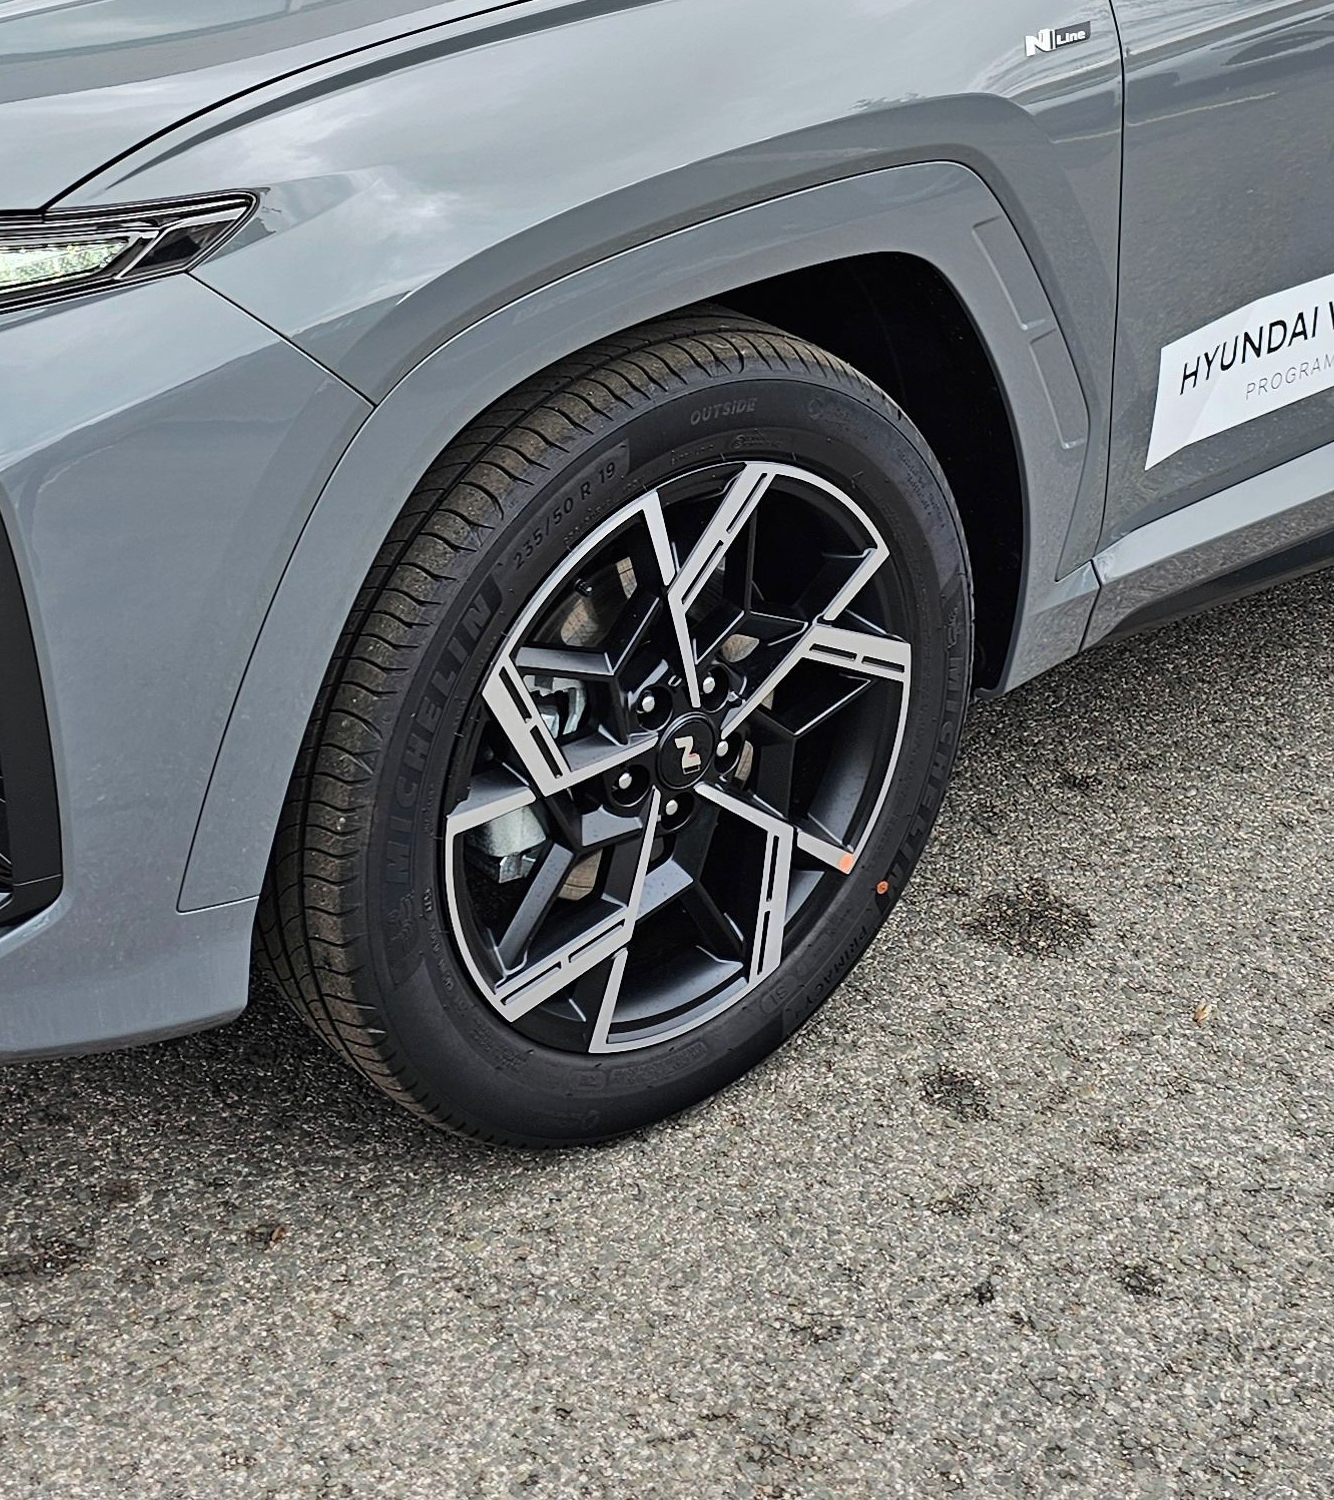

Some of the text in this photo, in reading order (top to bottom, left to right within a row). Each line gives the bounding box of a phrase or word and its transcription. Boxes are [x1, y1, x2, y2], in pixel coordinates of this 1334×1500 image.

[1025, 28, 1051, 57] N
[1179, 305, 1319, 396] HYUNDAI
[690, 397, 758, 426] OUTSIDE
[512, 461, 616, 572] 235/50 R 19
[384, 587, 496, 887] MICHELIN
[805, 925, 869, 1010] PRIMACY
